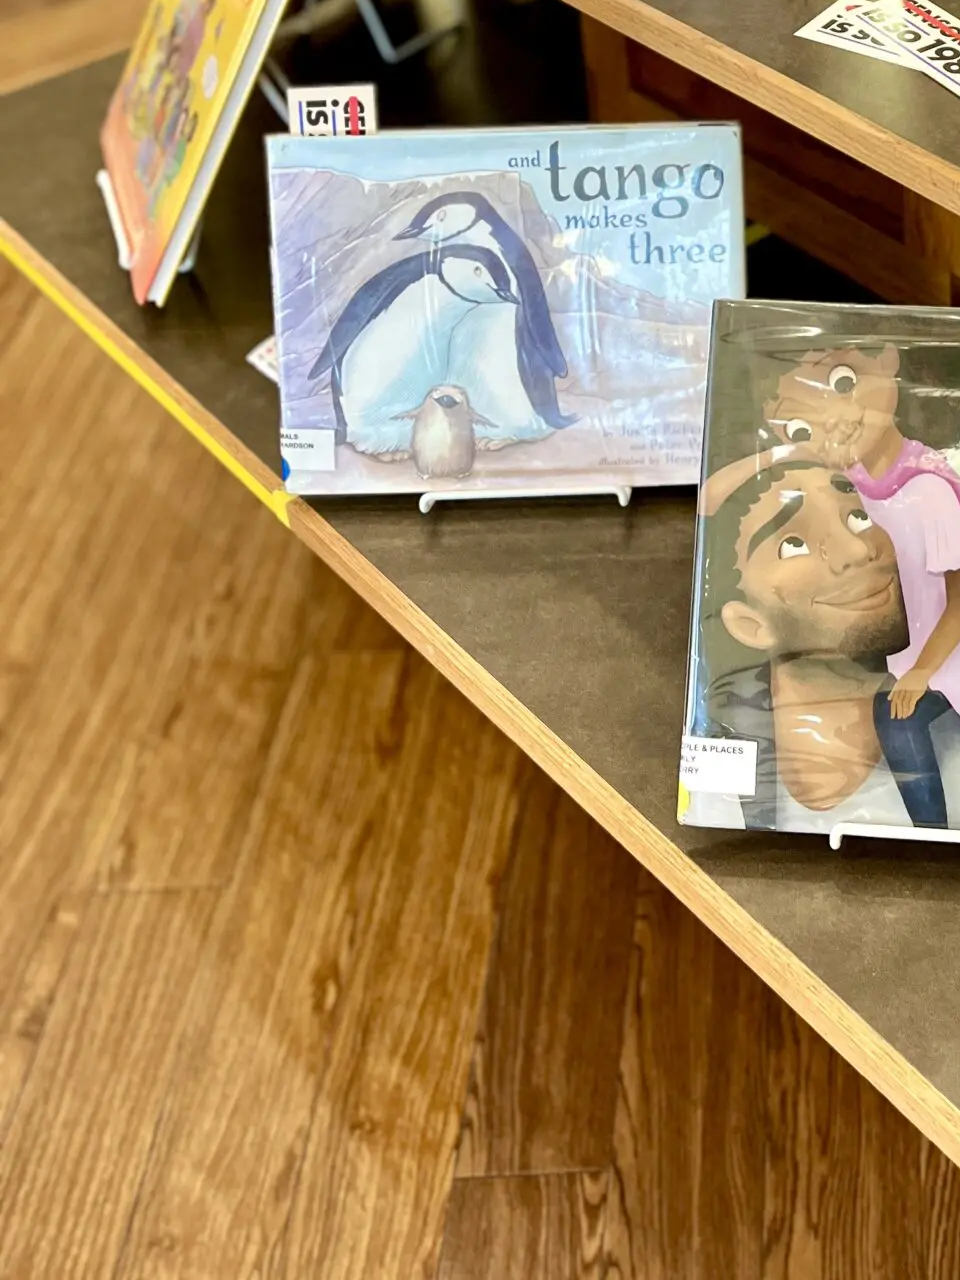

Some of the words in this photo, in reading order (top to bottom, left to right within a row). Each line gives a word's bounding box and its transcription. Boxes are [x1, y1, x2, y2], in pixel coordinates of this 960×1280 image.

[507, 151, 541, 170] and
[545, 140, 725, 219] tango
[564, 206, 647, 231] makes
[629, 232, 727, 265] three
[702, 744, 708, 752] &
[710, 745, 744, 755] PLACES
